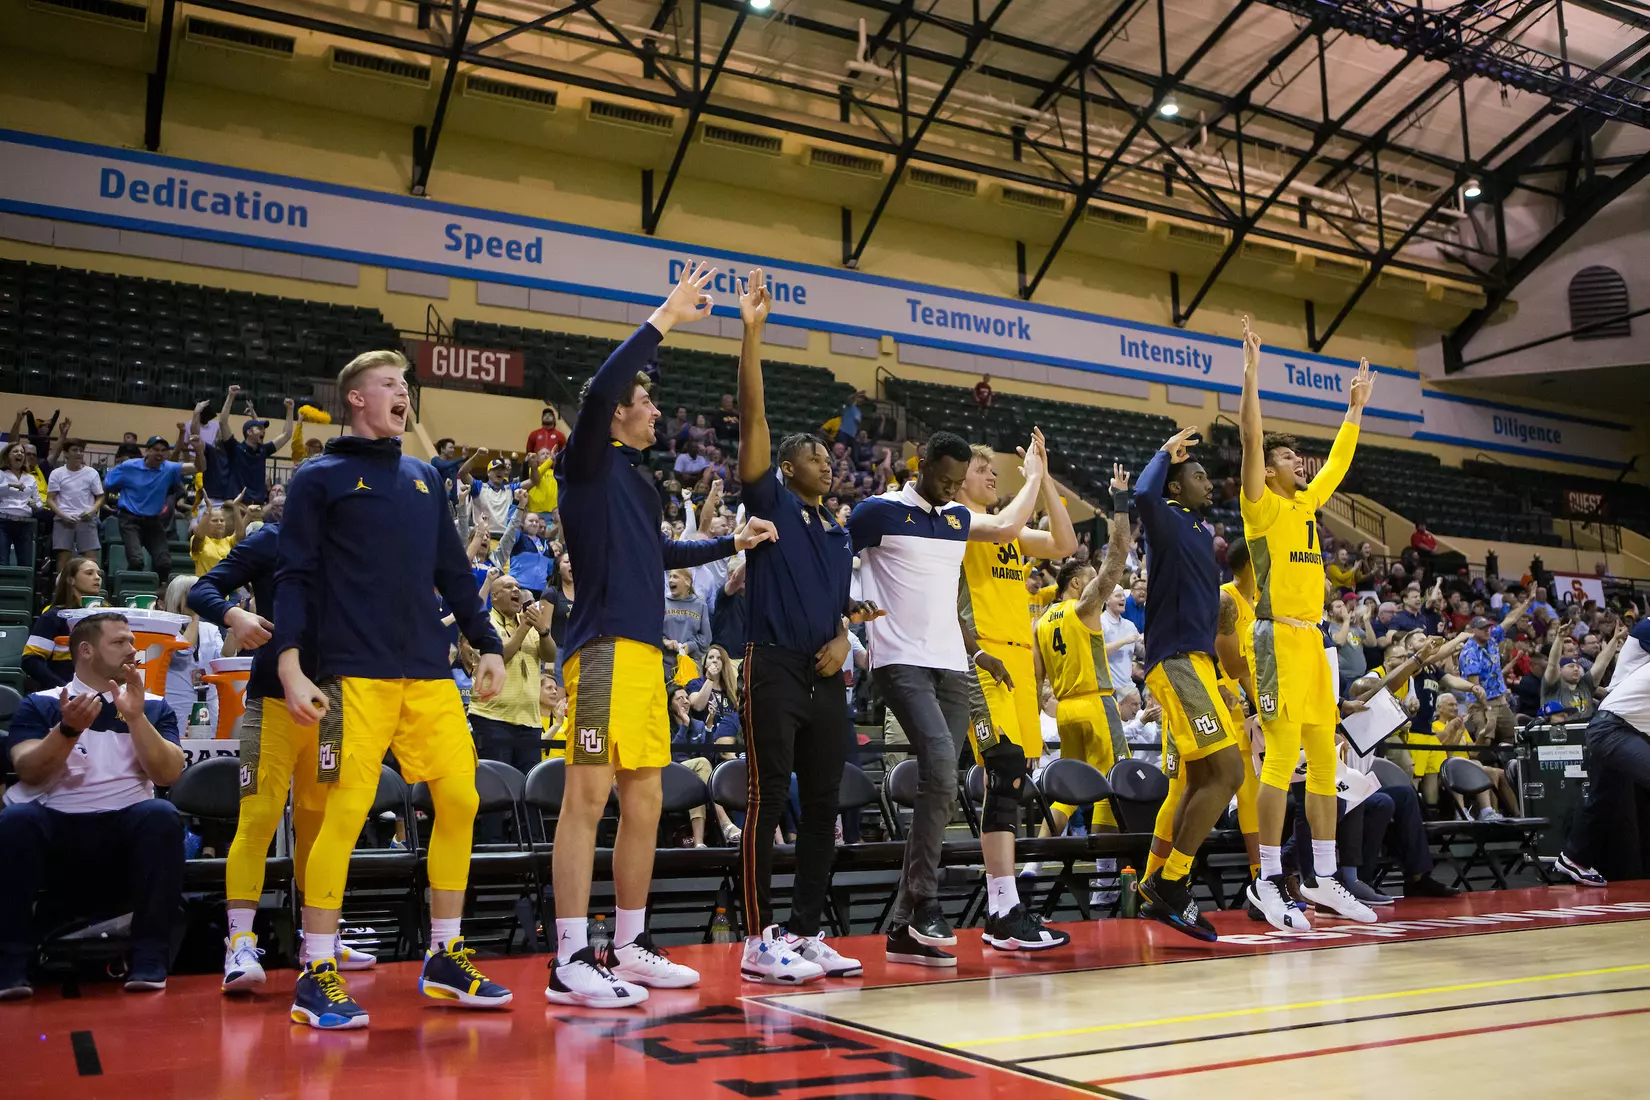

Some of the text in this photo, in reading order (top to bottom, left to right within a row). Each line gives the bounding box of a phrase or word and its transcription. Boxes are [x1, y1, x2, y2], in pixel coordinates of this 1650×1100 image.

[100, 168, 308, 228] Dedication
[444, 223, 543, 264] Speed
[669, 259, 806, 305] Disciine
[906, 298, 1031, 341] Teamwork
[432, 345, 511, 383] GUEST
[1120, 334, 1212, 375] Intensity
[1284, 363, 1343, 393] Talent
[1493, 415, 1562, 444] Diligence
[1305, 520, 1314, 549] 1
[1052, 627, 1067, 656] 4
[1194, 714, 1219, 735] MU
[579, 727, 604, 753] MU
[319, 742, 337, 771] MU
